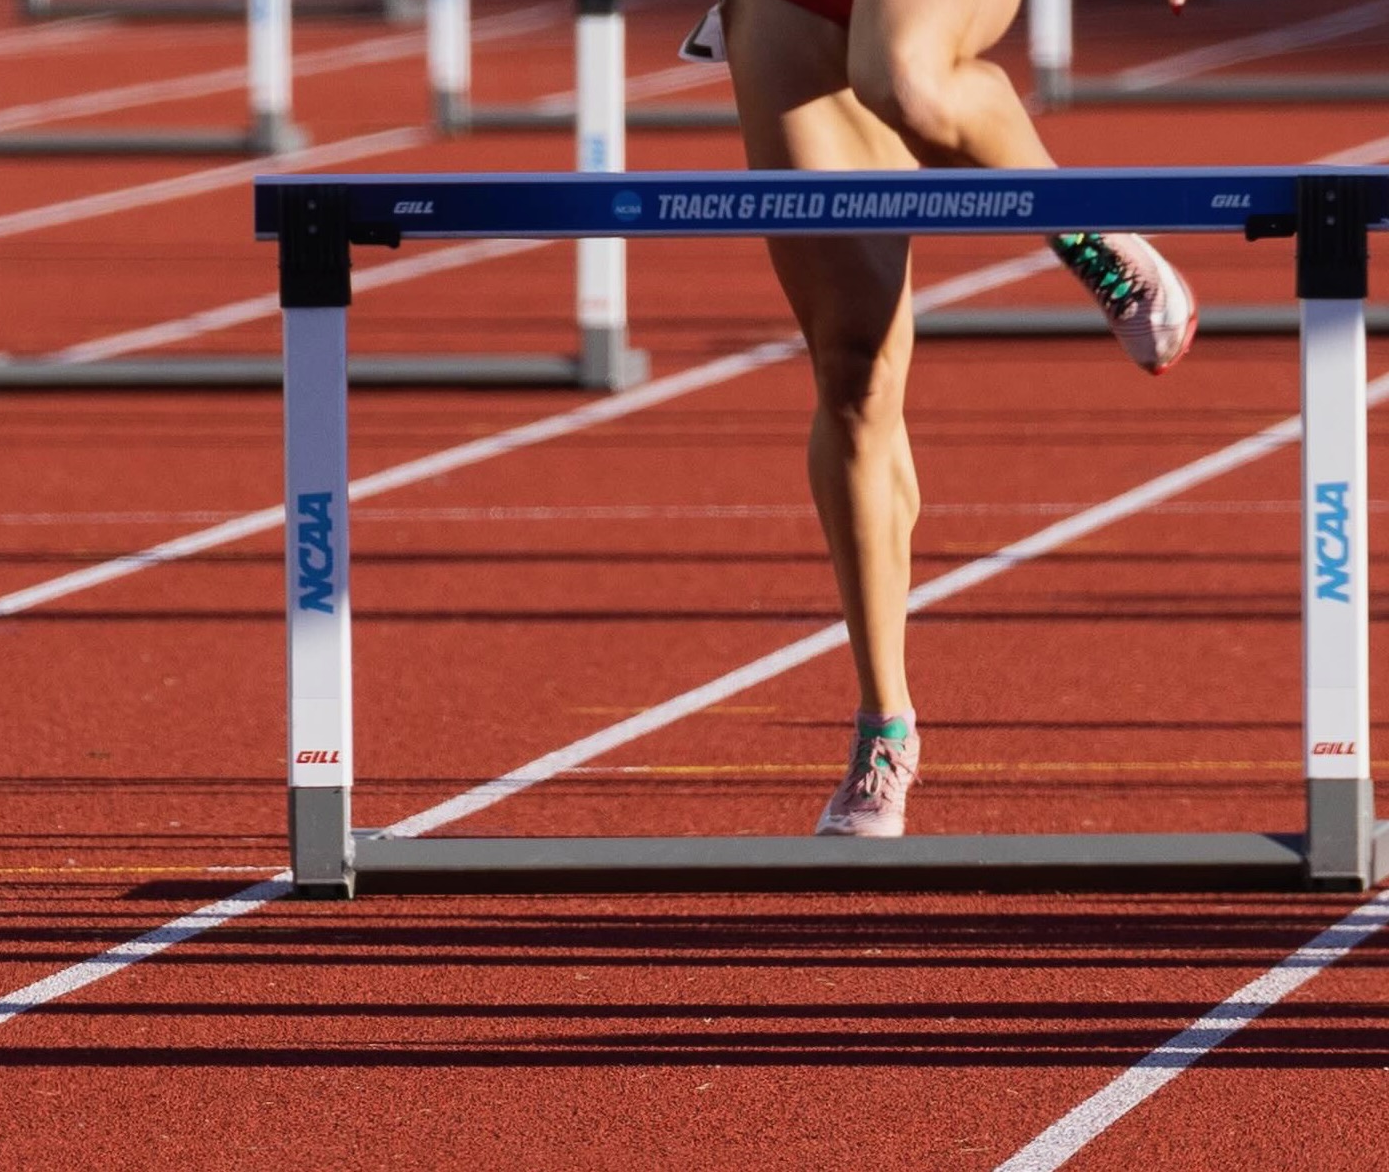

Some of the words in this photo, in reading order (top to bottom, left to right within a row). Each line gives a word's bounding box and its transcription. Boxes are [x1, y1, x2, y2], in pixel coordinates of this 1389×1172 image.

[394, 201, 434, 214] GILL
[658, 194, 740, 219] TRACK
[738, 194, 756, 219] &
[760, 193, 823, 219] FIELD
[831, 191, 1034, 218] CHAMPIONSHIPS
[1211, 194, 1250, 207] GILL
[1315, 481, 1350, 604] NCAA
[297, 492, 334, 614] NCAA
[1312, 742, 1357, 755] GILL
[296, 750, 340, 764] GILL
